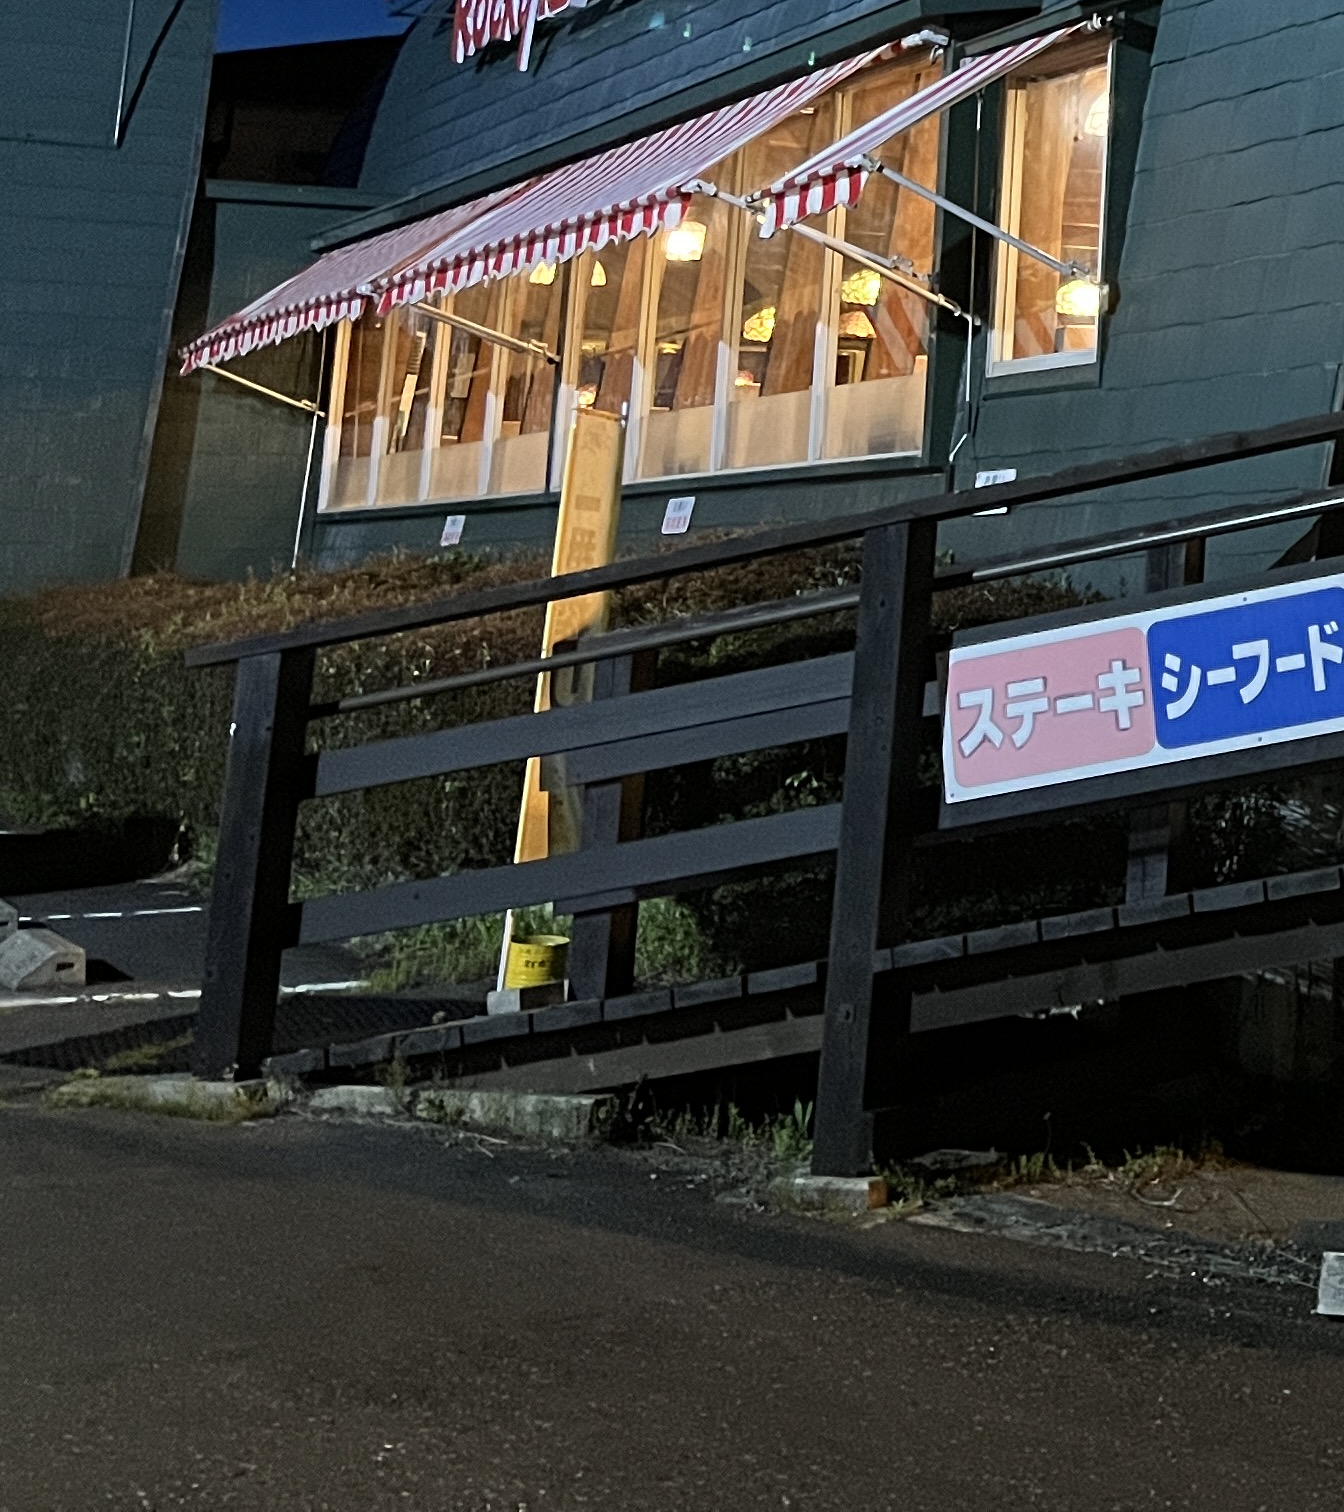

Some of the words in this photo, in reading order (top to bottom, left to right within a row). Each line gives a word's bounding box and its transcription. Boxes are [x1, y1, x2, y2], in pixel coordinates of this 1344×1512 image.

[959, 660, 1144, 758] ステーキ
[1161, 621, 1343, 719] シーフード
